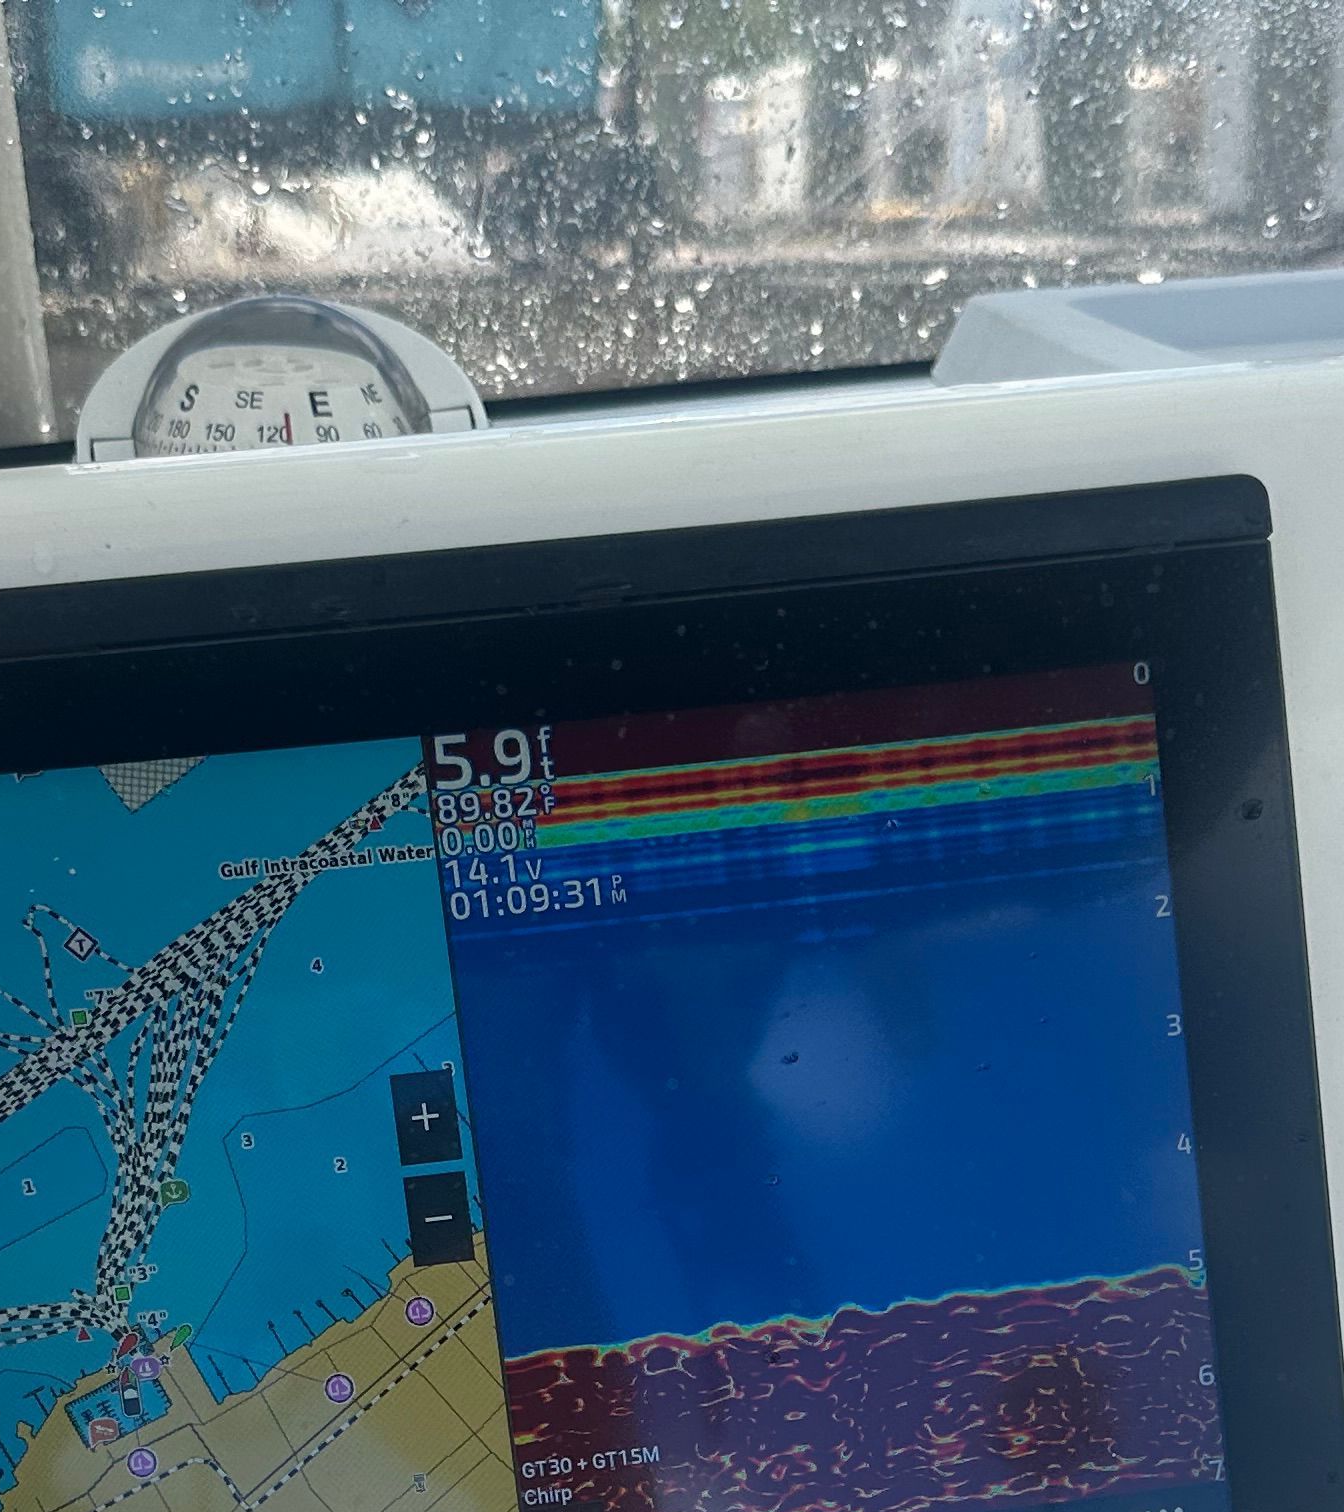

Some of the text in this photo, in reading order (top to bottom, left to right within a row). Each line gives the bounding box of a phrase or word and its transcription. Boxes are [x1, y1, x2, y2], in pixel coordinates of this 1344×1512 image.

[180, 383, 383, 417] S SE E NE
[167, 420, 191, 439] 180
[206, 424, 235, 442] 150
[257, 426, 289, 443] 120
[316, 426, 339, 442] 90
[1133, 662, 1150, 685] 0
[433, 729, 531, 790] 5.9
[1143, 774, 1155, 796] 1
[437, 787, 536, 824] 89.82
[441, 822, 519, 855] 0.00
[220, 846, 434, 879] Gulf Intracoastal Water
[445, 854, 517, 888] 14.1
[450, 877, 603, 920] 01:09:31
[1154, 895, 1171, 918] 2
[311, 959, 324, 974] 4
[1166, 1014, 1182, 1037] 3
[242, 1134, 254, 1148] 3
[1177, 1133, 1192, 1154] 4
[334, 1158, 347, 1172] 2
[23, 1180, 35, 1195] 1
[1189, 1249, 1204, 1271] 5
[1199, 1364, 1215, 1386] 6
[521, 1457, 573, 1479] GT30
[592, 1446, 660, 1471] GT15M
[524, 1486, 573, 1506] Chirp
